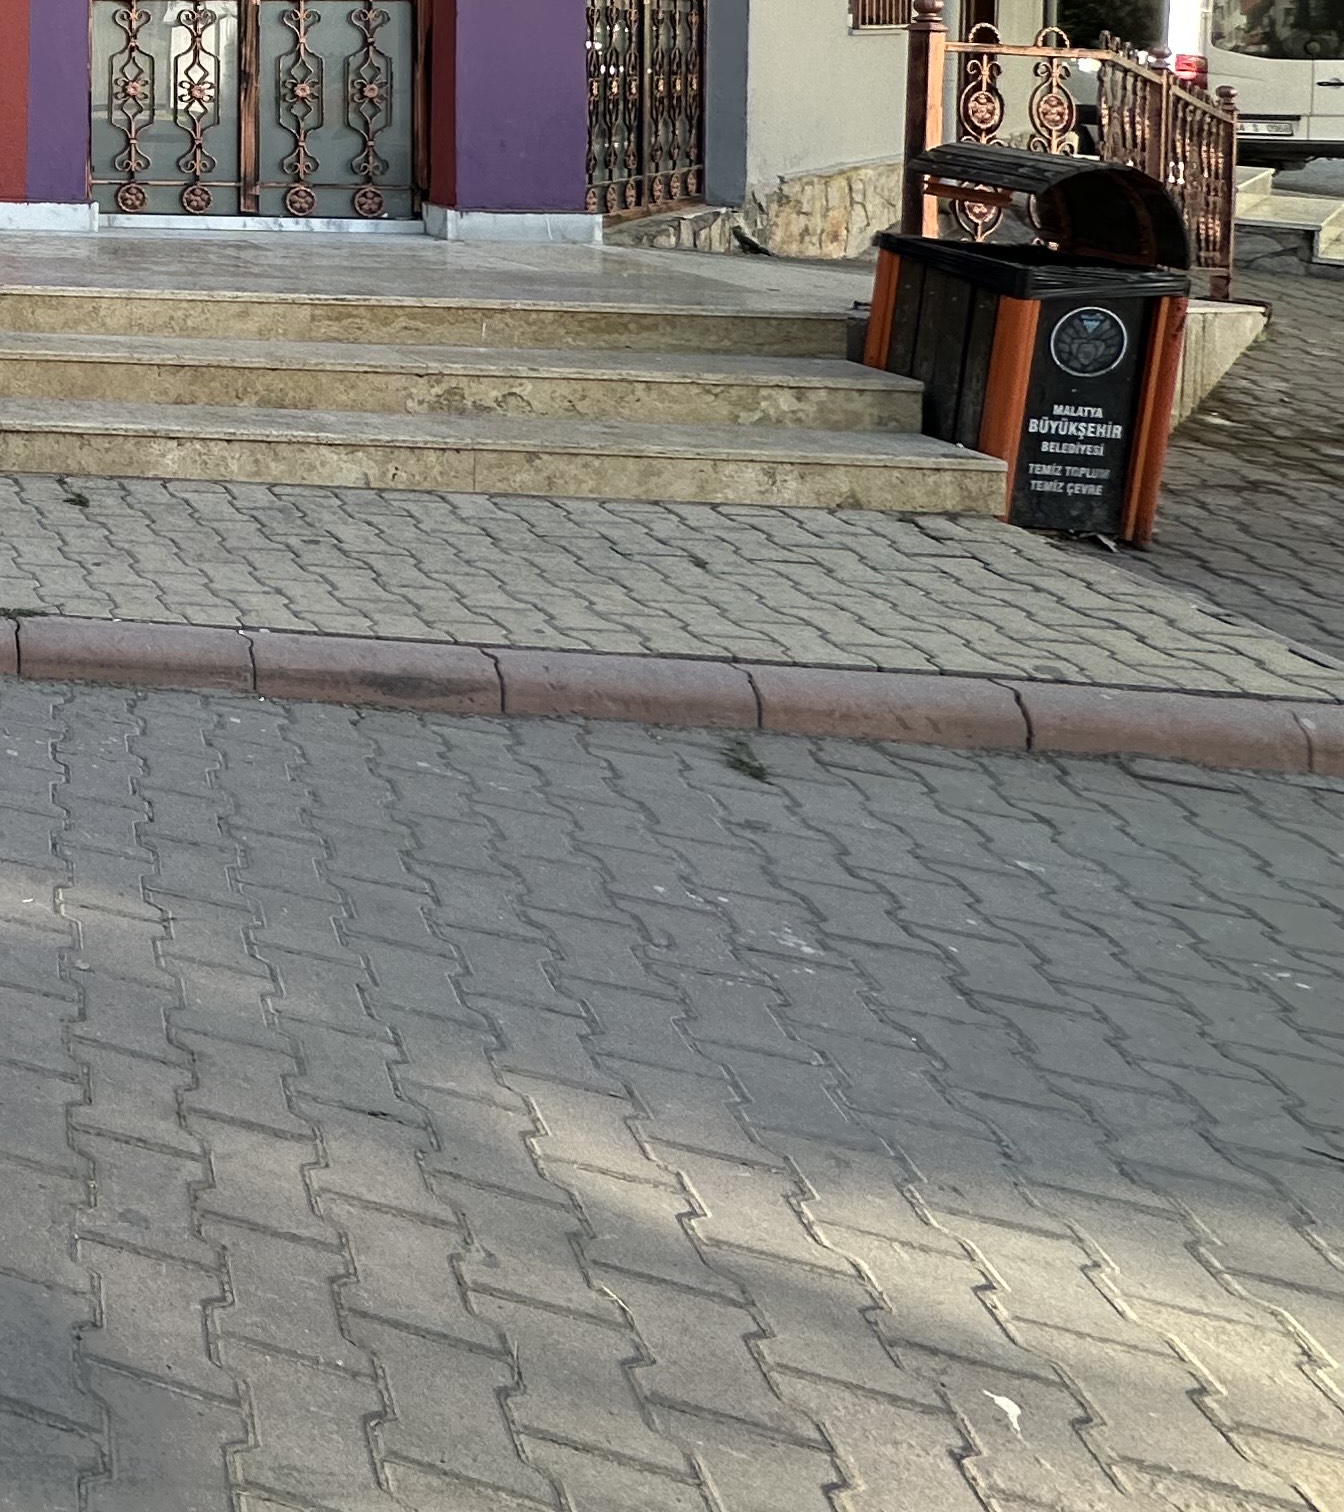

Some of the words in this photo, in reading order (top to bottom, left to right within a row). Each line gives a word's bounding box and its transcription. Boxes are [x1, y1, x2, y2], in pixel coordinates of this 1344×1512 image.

[1053, 404, 1104, 418] MALATYA
[1028, 416, 1123, 440] BÜYÜKŞEHİR
[1040, 441, 1105, 457] BELEDİYESİ
[1028, 463, 1063, 476] TEMİZ
[1030, 480, 1064, 493] TEMİZ
[1066, 482, 1104, 496] ÇEVRE
